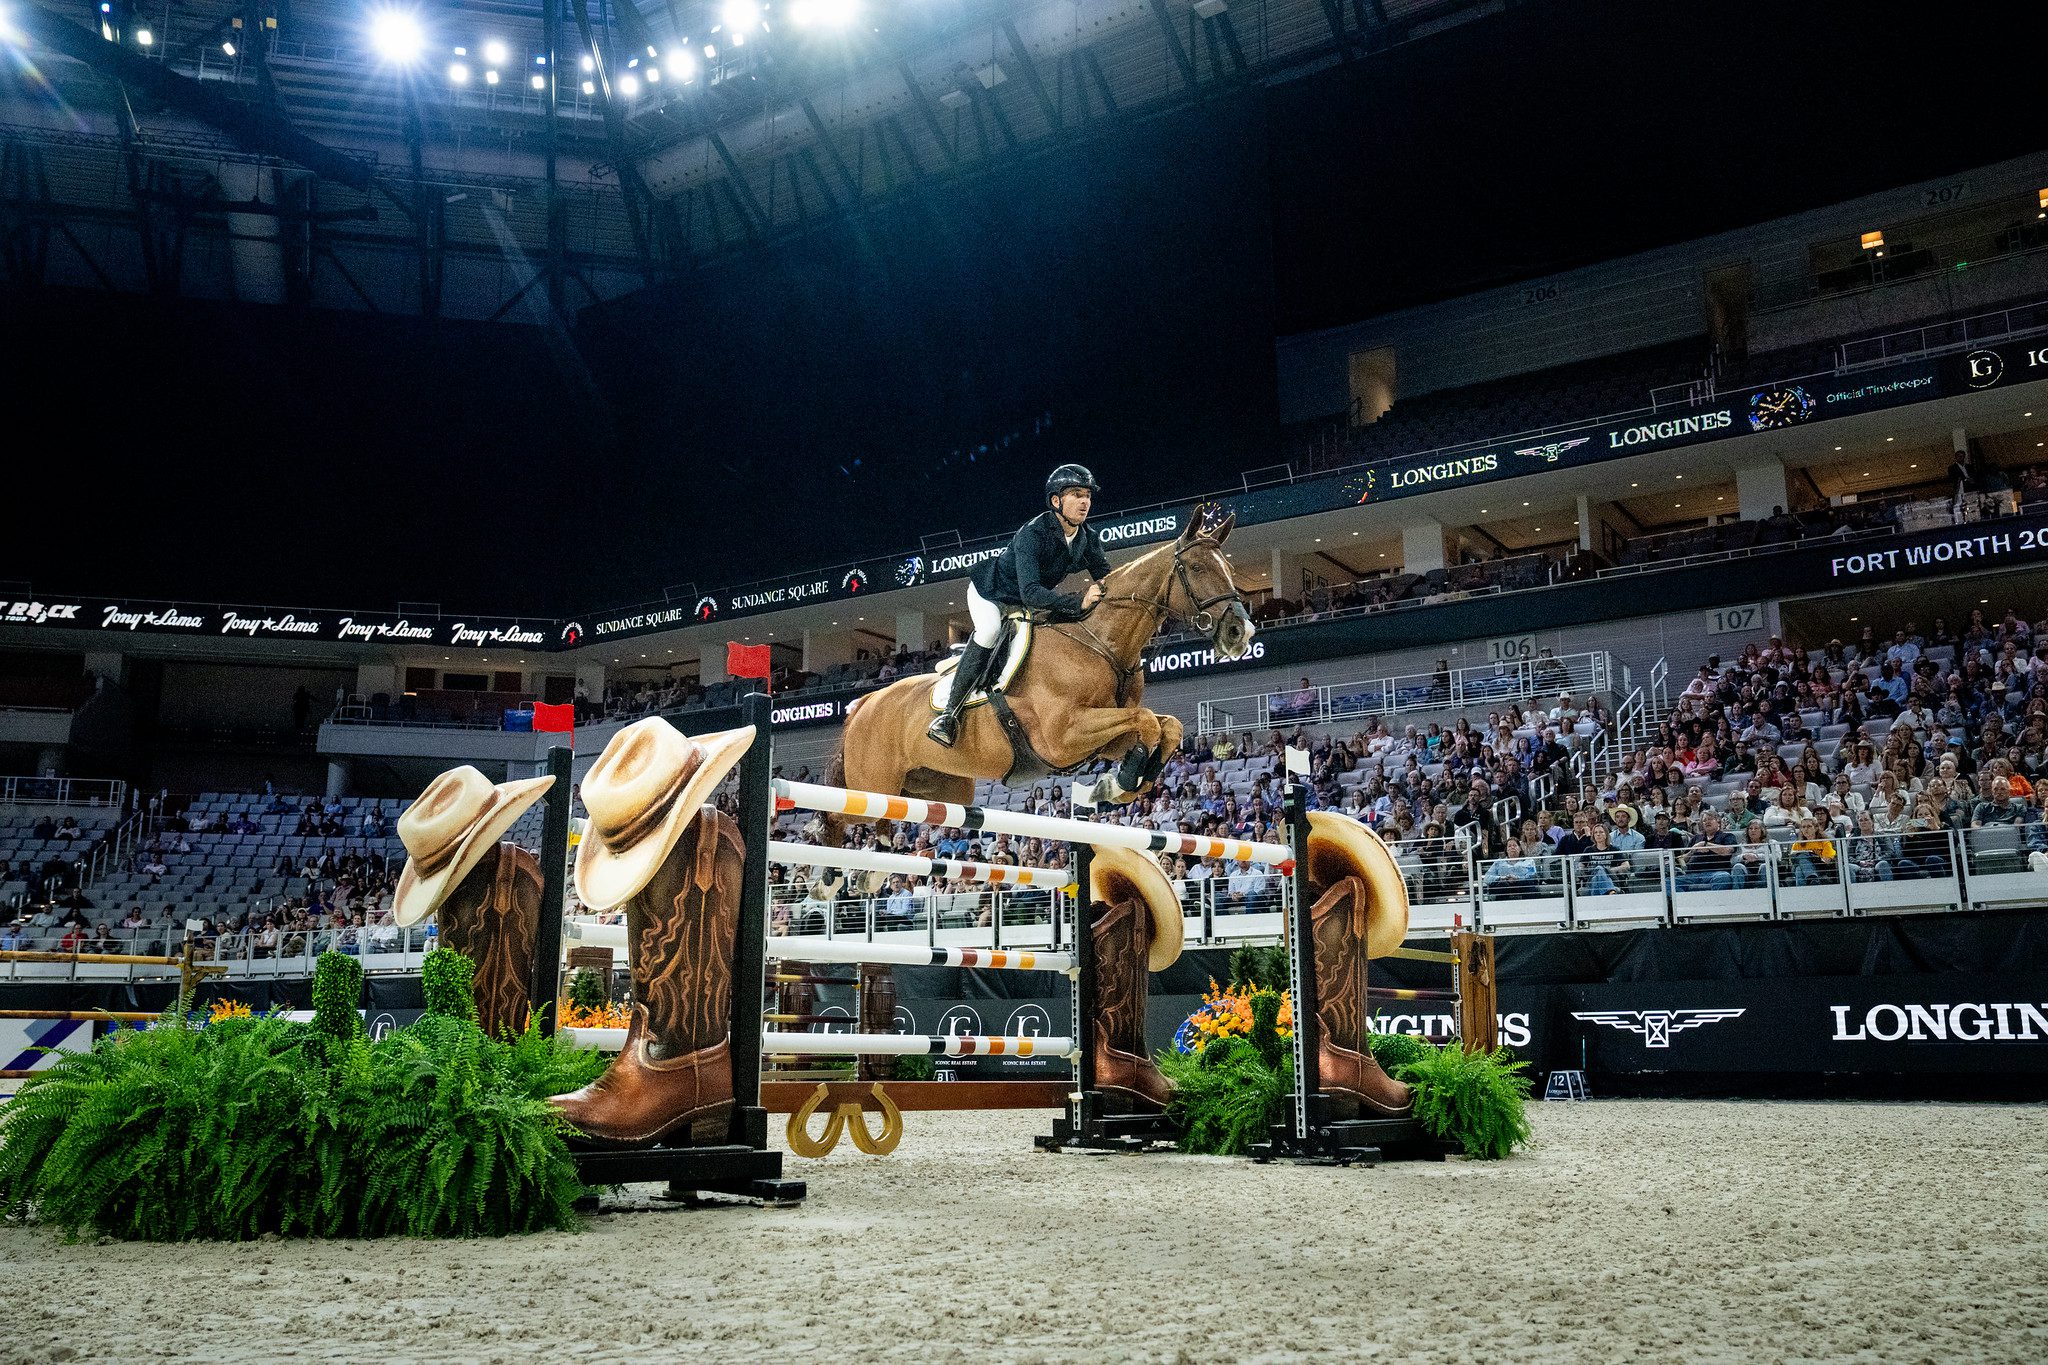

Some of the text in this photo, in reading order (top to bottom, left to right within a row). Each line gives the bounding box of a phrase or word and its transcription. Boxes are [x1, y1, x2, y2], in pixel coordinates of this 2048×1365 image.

[1609, 411, 1732, 448] LONGINES
[1391, 454, 1498, 489] LONGINES
[1098, 513, 1178, 545] ONGINES
[1832, 550, 1899, 576] FORT
[1905, 534, 2010, 565] WORTH
[732, 581, 828, 612] SUNDANCE SQUARE
[102, 606, 202, 630] Tony Lama
[222, 612, 318, 635] Tony Lama
[338, 618, 432, 641] Tony Lama
[596, 608, 681, 634] SUNDANCE SQUARE
[1714, 608, 1757, 632] 107
[451, 623, 545, 646] Tony Lama
[1150, 649, 1215, 672] WORTH
[1217, 641, 1265, 665] 26
[1491, 638, 1532, 660] 106
[771, 701, 833, 723] ONGINES
[1830, 1003, 2048, 1040] LONGIN
[1553, 1074, 1565, 1086] 12
